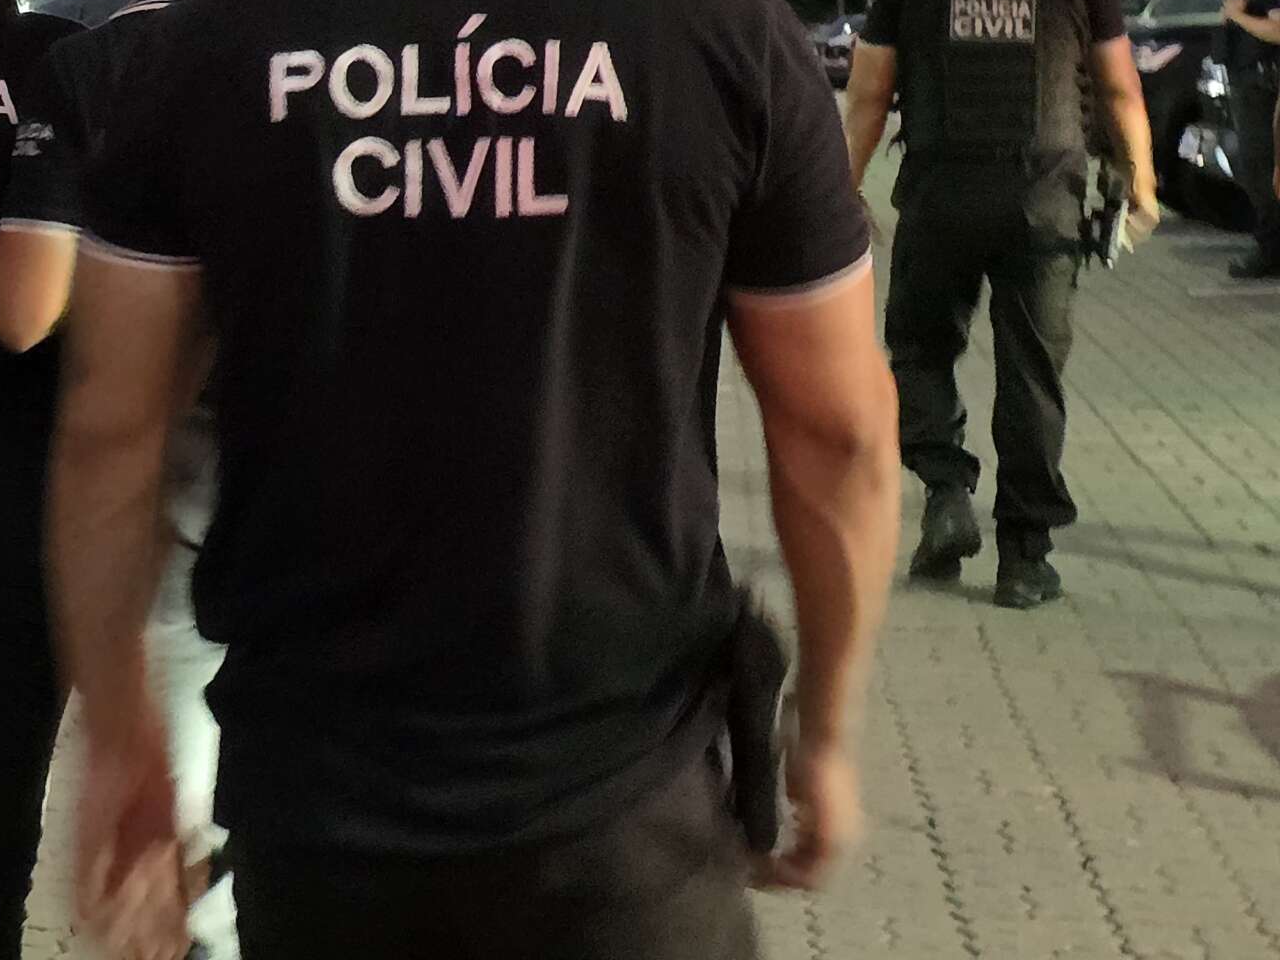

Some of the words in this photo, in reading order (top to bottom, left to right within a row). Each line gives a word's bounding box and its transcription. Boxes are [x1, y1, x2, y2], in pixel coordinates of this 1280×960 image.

[268, 13, 628, 123] POLÍCIA
[954, 16, 1033, 40] CIVIL
[332, 135, 569, 219] CIVIL
